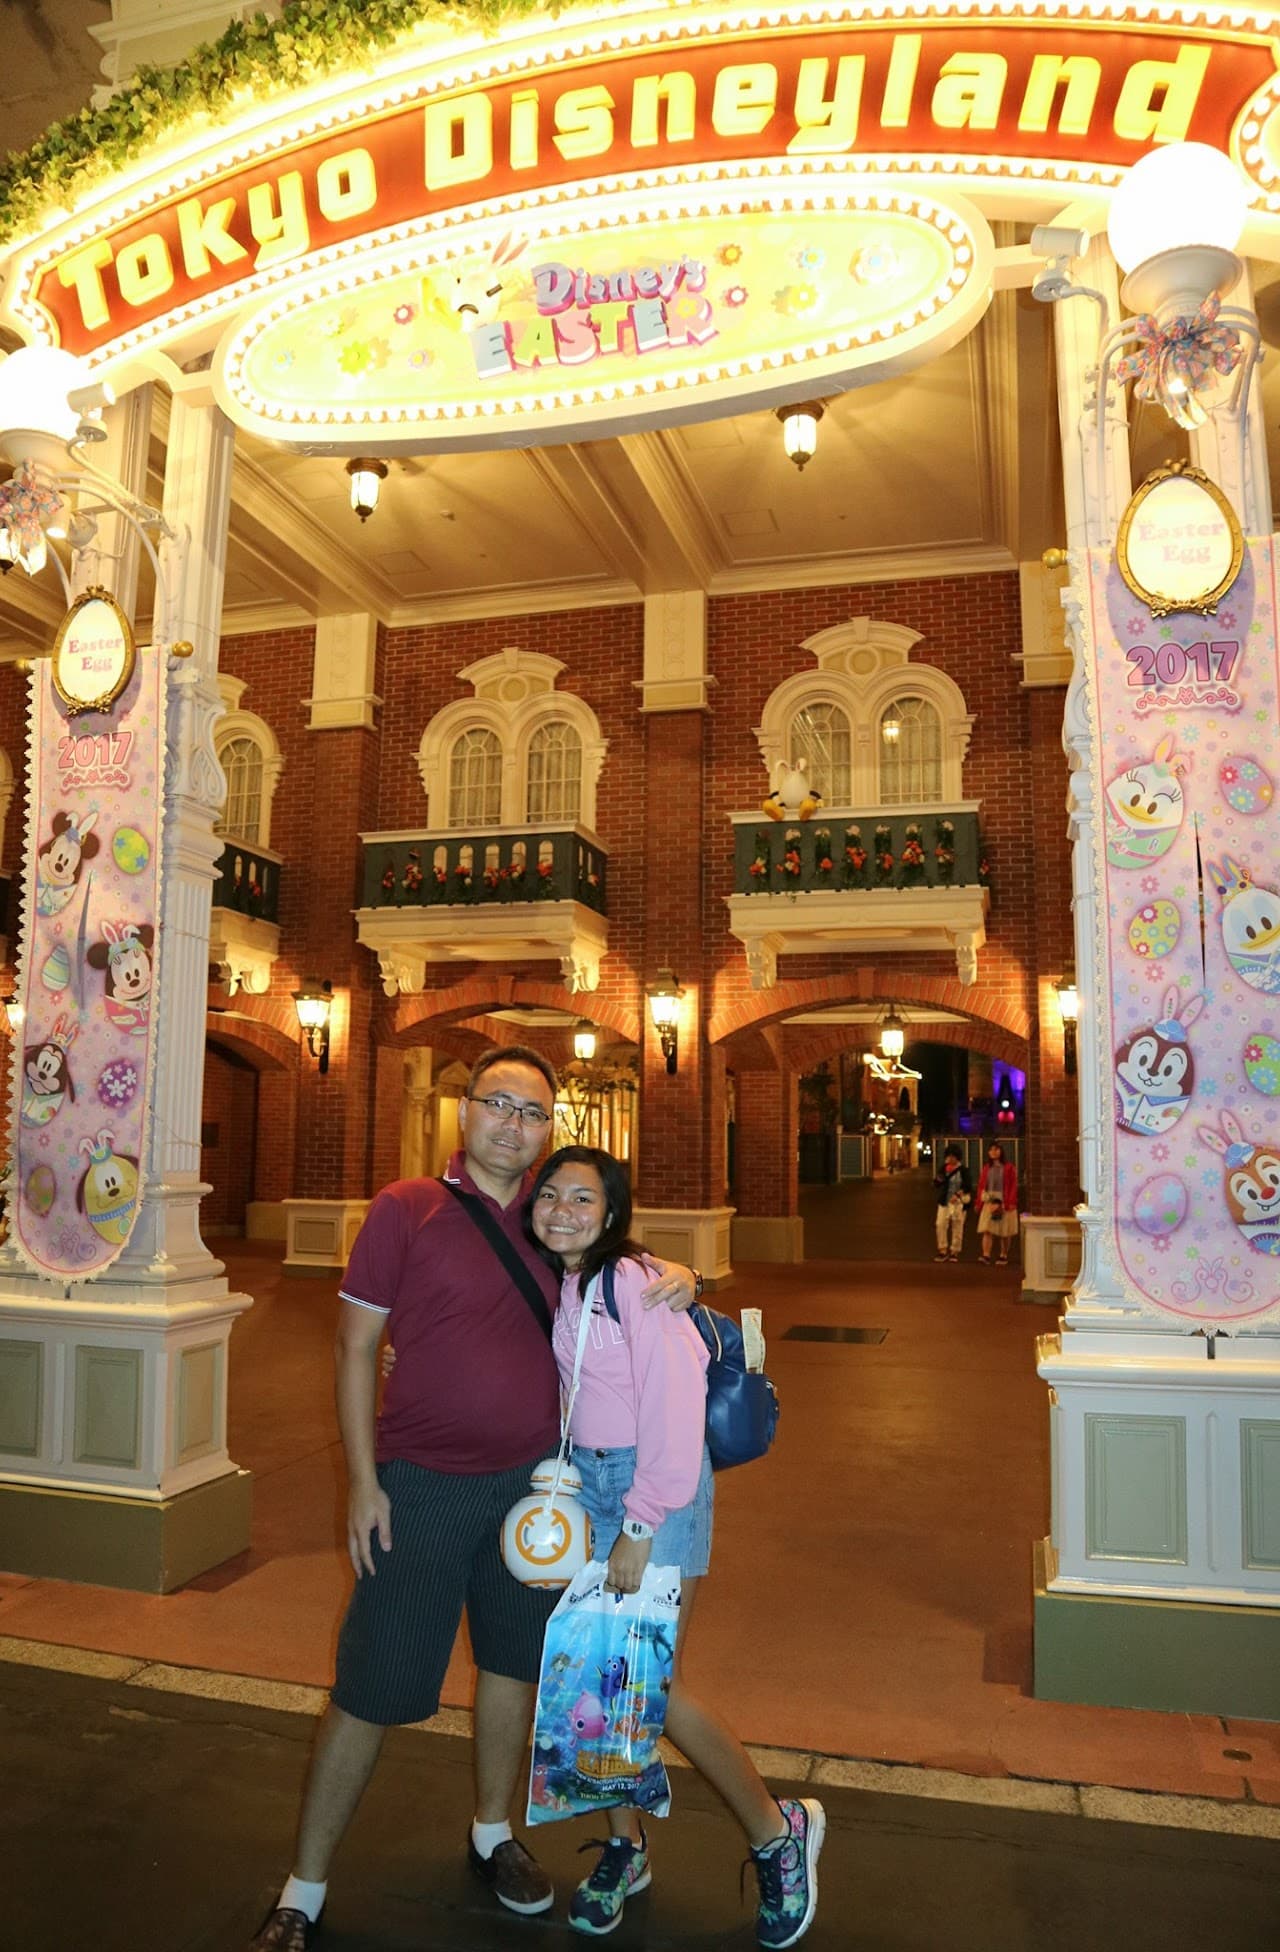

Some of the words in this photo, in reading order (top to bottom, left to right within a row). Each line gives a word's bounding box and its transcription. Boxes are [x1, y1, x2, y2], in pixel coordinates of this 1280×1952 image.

[57, 147, 380, 332] Tokyo
[424, 33, 1212, 192] Disneyland
[532, 254, 706, 316] Disney's
[470, 294, 720, 380] EASTER
[1139, 522, 1226, 542] Easter
[1163, 544, 1212, 565] Egg
[68, 636, 122, 654] Easter
[81, 656, 113, 672] Egg
[1125, 640, 1240, 686] 2017
[57, 731, 132, 769] 2017
